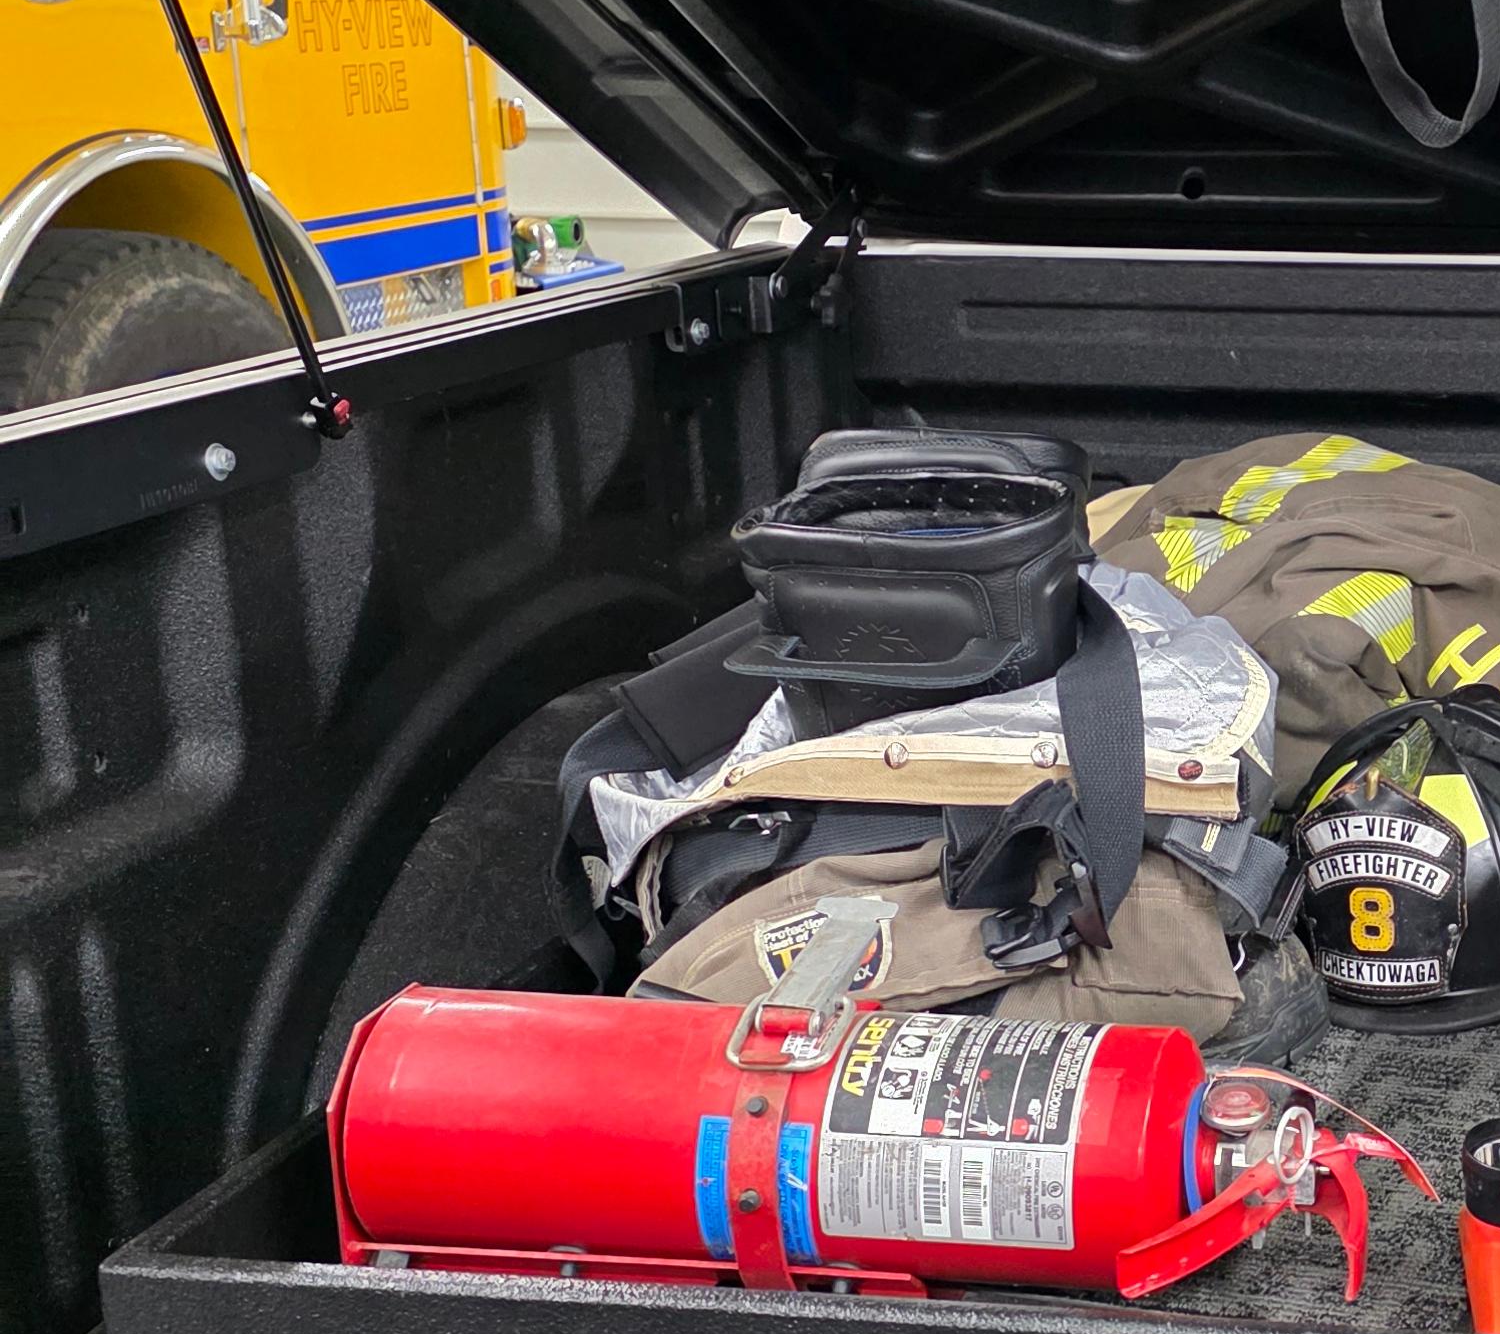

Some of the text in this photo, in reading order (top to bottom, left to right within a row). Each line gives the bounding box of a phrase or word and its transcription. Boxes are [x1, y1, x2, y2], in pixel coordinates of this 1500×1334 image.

[341, 60, 409, 116] FIRE
[1328, 817, 1419, 844] HY-VIEW
[1315, 854, 1439, 891] FIREFIGHTER
[1349, 886, 1396, 953] 8
[1323, 950, 1438, 984] CHEEKTOWAGA
[1045, 1050, 1076, 1130] INSTRUCCIONES
[1064, 1036, 1093, 1090] INSTRUCTIONS
